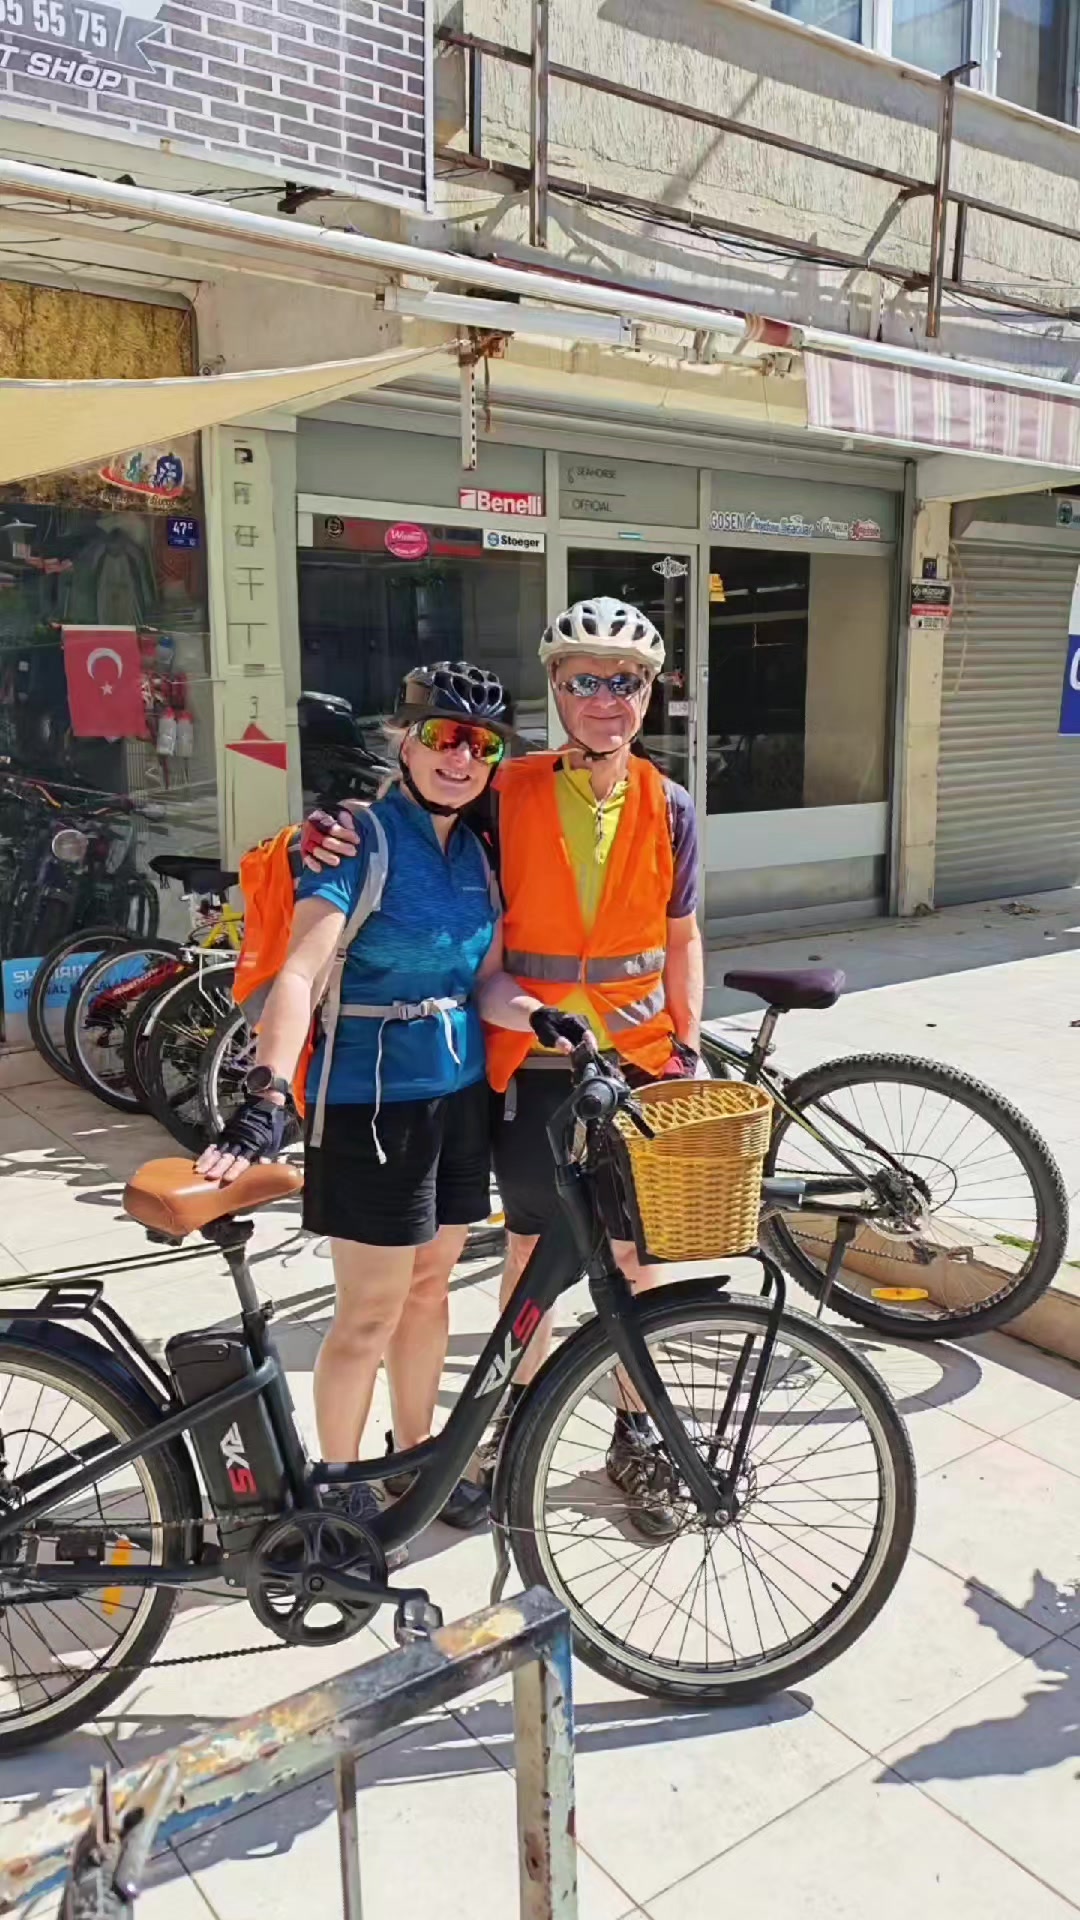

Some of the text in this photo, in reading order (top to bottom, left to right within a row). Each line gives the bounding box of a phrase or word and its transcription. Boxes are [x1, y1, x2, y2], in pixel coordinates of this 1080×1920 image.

[33, 0, 66, 37] 55
[75, 8, 107, 47] 75
[27, 52, 121, 90] SHOP
[477, 490, 542, 515] Benelli
[711, 510, 745, 531] GOSEN
[500, 534, 540, 549] Stoeger
